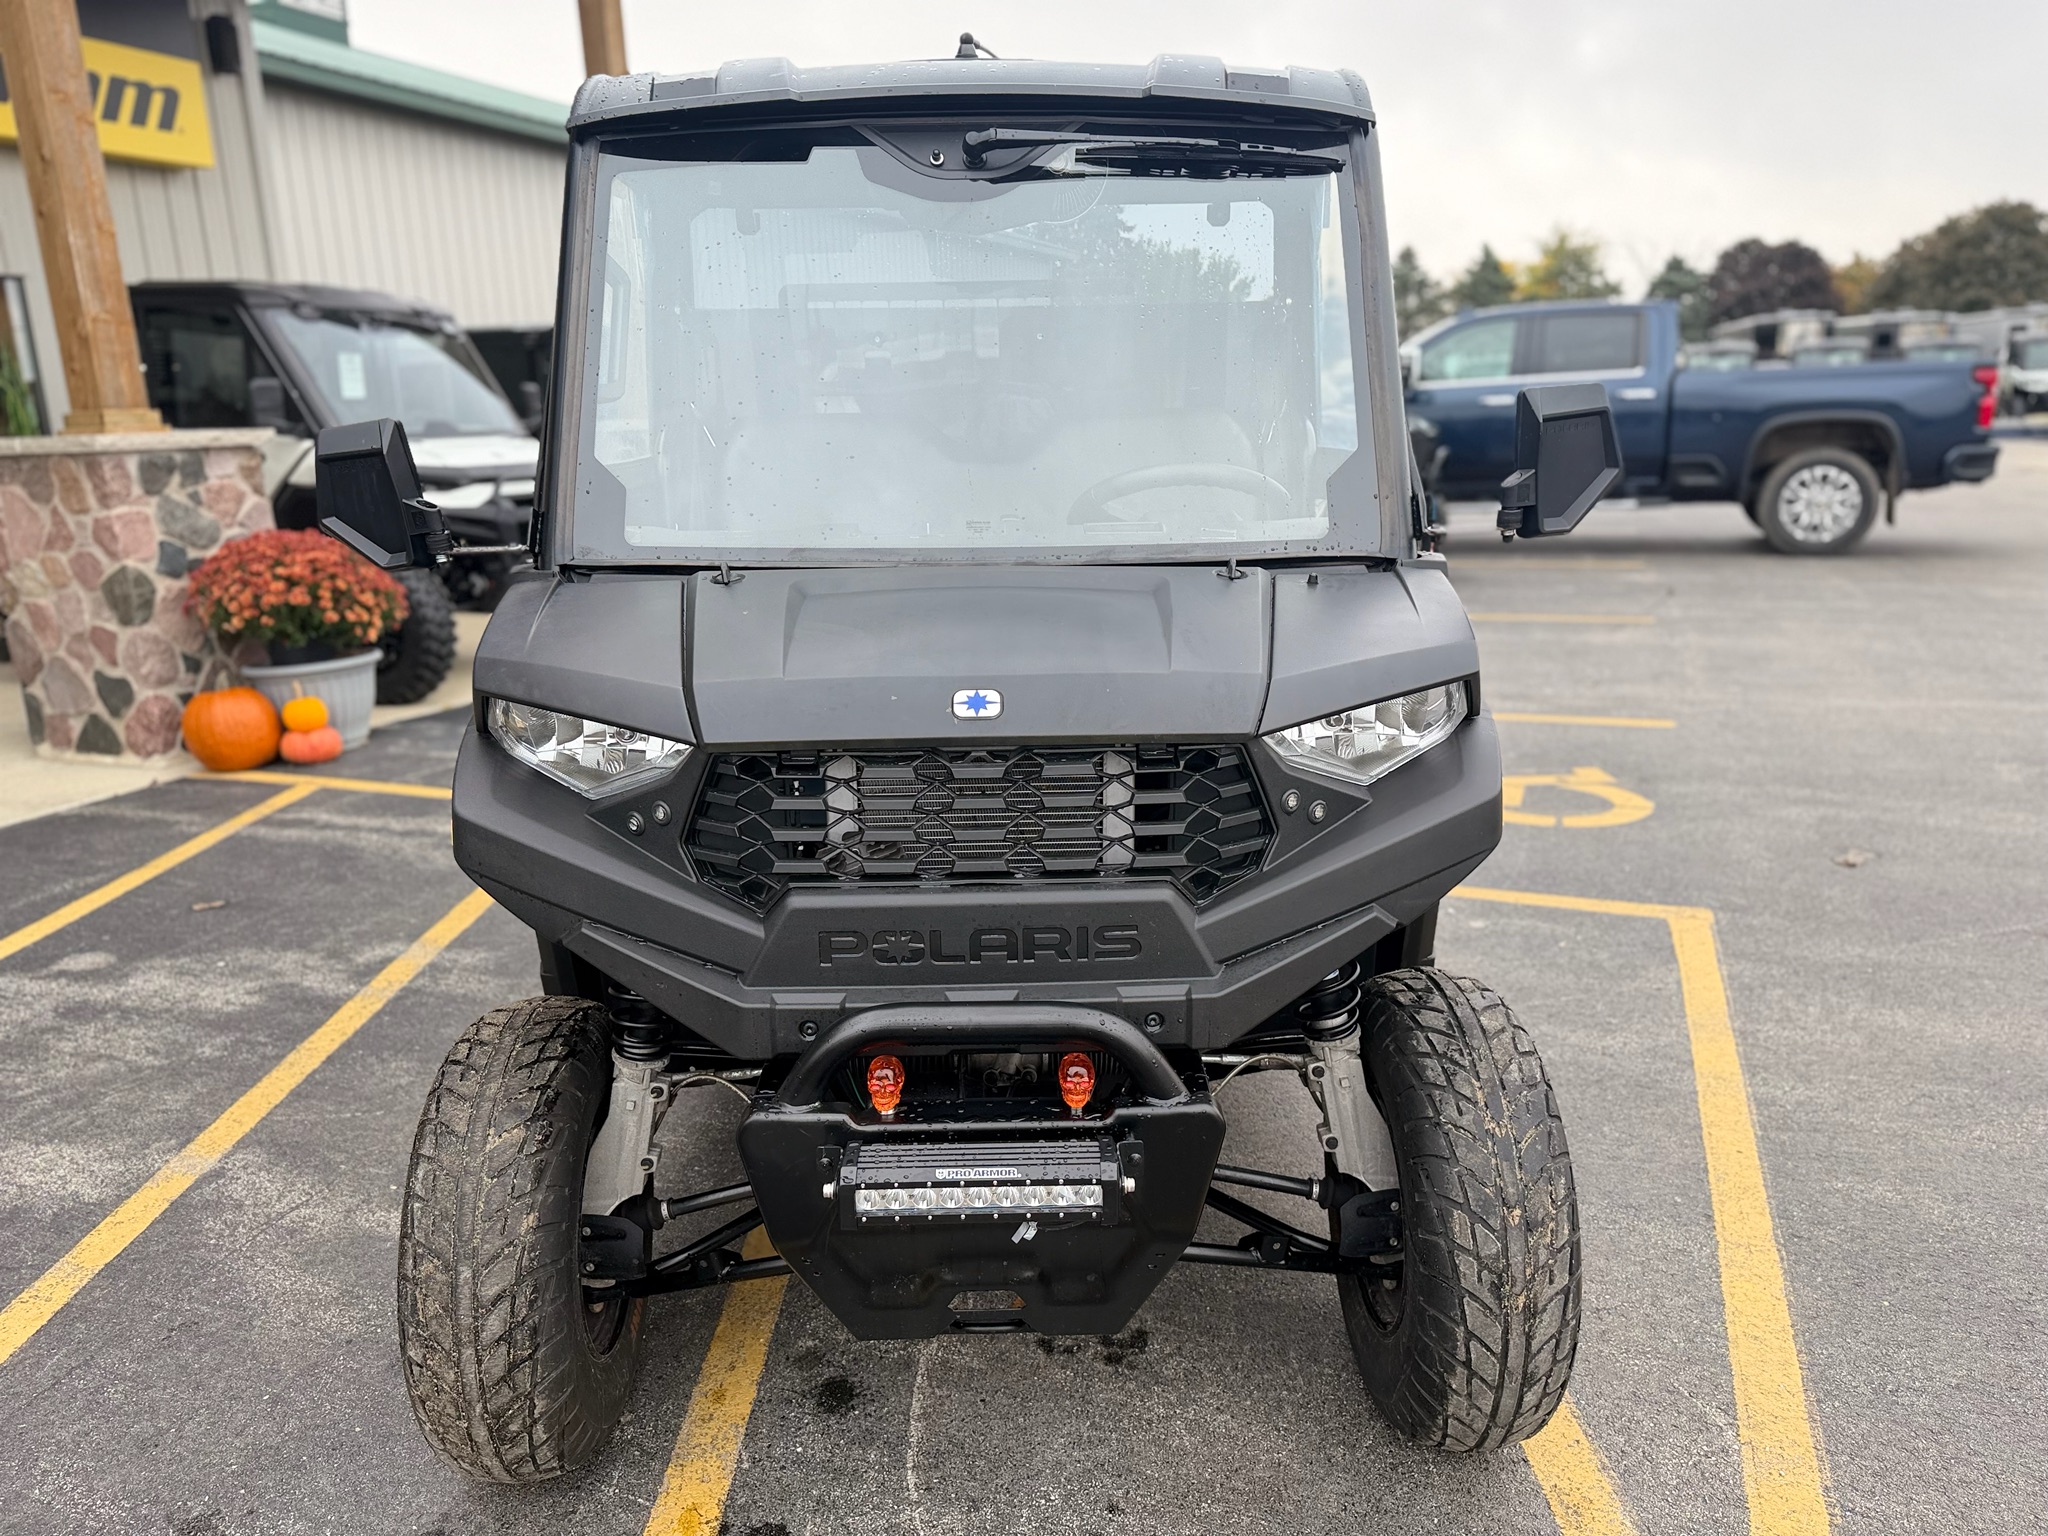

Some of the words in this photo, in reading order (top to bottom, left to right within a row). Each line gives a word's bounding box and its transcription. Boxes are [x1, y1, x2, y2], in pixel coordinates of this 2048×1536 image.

[818, 925, 1142, 966] POLARIS
[947, 1169, 972, 1179] PRO
[973, 1168, 1017, 1178] ARMOR
